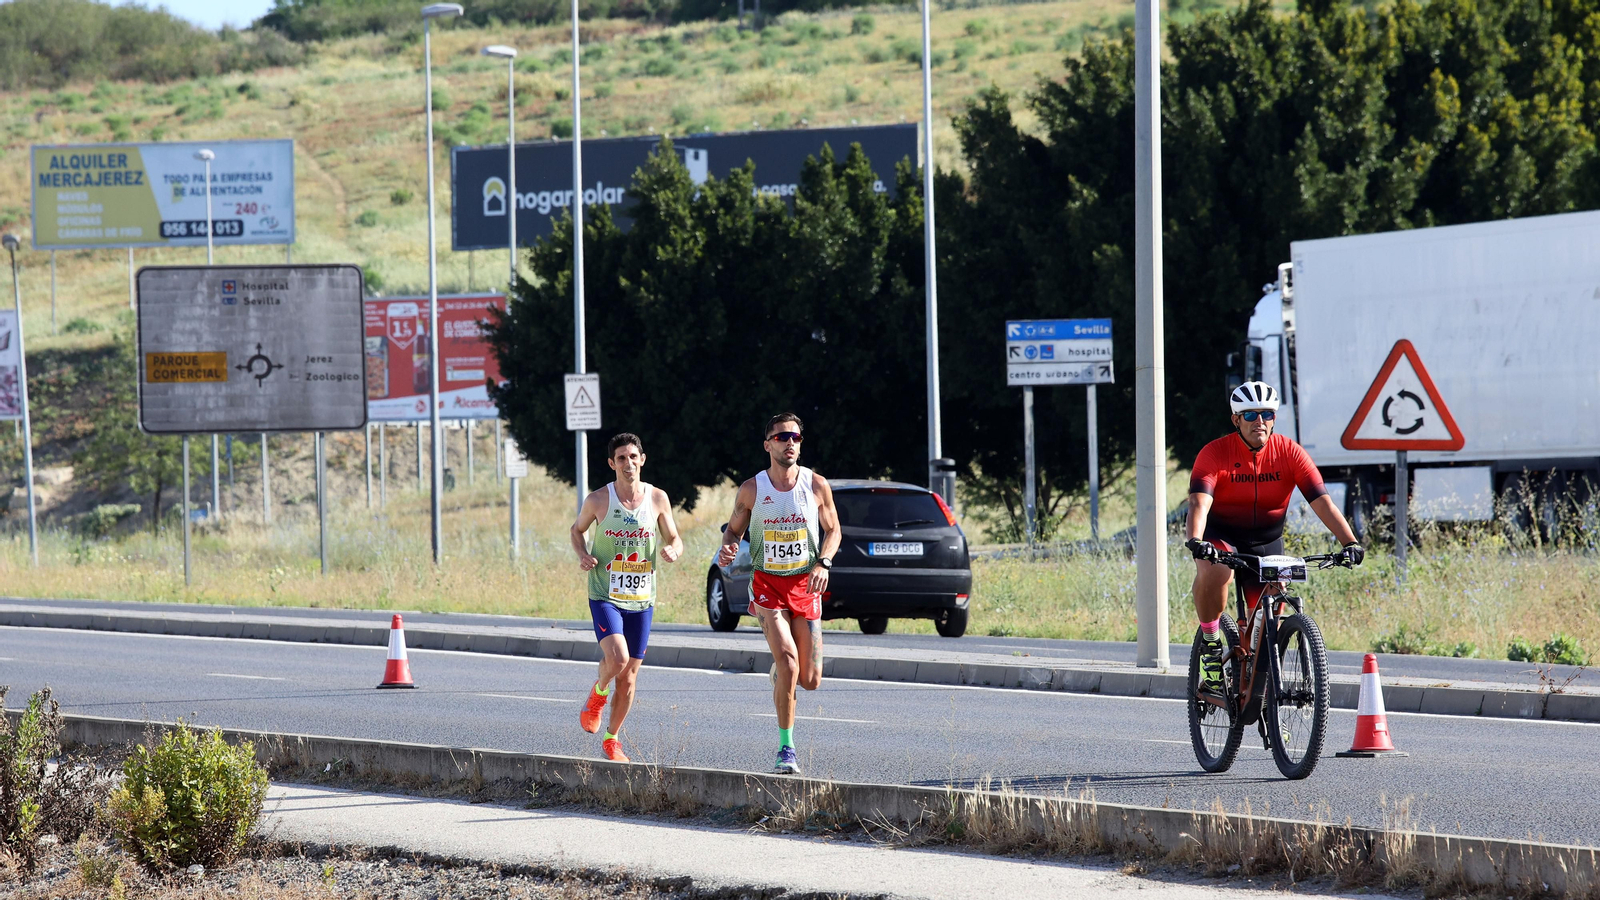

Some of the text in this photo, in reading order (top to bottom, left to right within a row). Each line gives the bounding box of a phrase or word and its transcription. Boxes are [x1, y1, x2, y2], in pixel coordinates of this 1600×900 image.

[50, 153, 128, 170] ALQUILER
[38, 171, 144, 188] MERCAJEREZ
[163, 171, 273, 185] TODO PAA EMPRESAS
[173, 183, 263, 197] DE ALIENTACIÓN
[513, 181, 625, 215] hogarolar
[235, 202, 258, 215] 240
[163, 222, 189, 236] 956
[215, 220, 240, 235] 013
[242, 281, 290, 292] Hospital
[243, 296, 281, 306] Sevilla
[1074, 324, 1111, 335] Sevilla
[1068, 346, 1112, 358] hospital
[152, 355, 199, 367] PARQUE
[304, 354, 334, 364] Jerez
[152, 368, 221, 380] COMERCIAL
[305, 371, 360, 382] Zoologico
[1009, 369, 1080, 379] centro urbano
[1230, 471, 1282, 483] TODO BIKE
[763, 512, 807, 525] maratón
[771, 542, 802, 559] 1543
[875, 544, 919, 553] 6649 DCG
[618, 574, 647, 589] 1395
